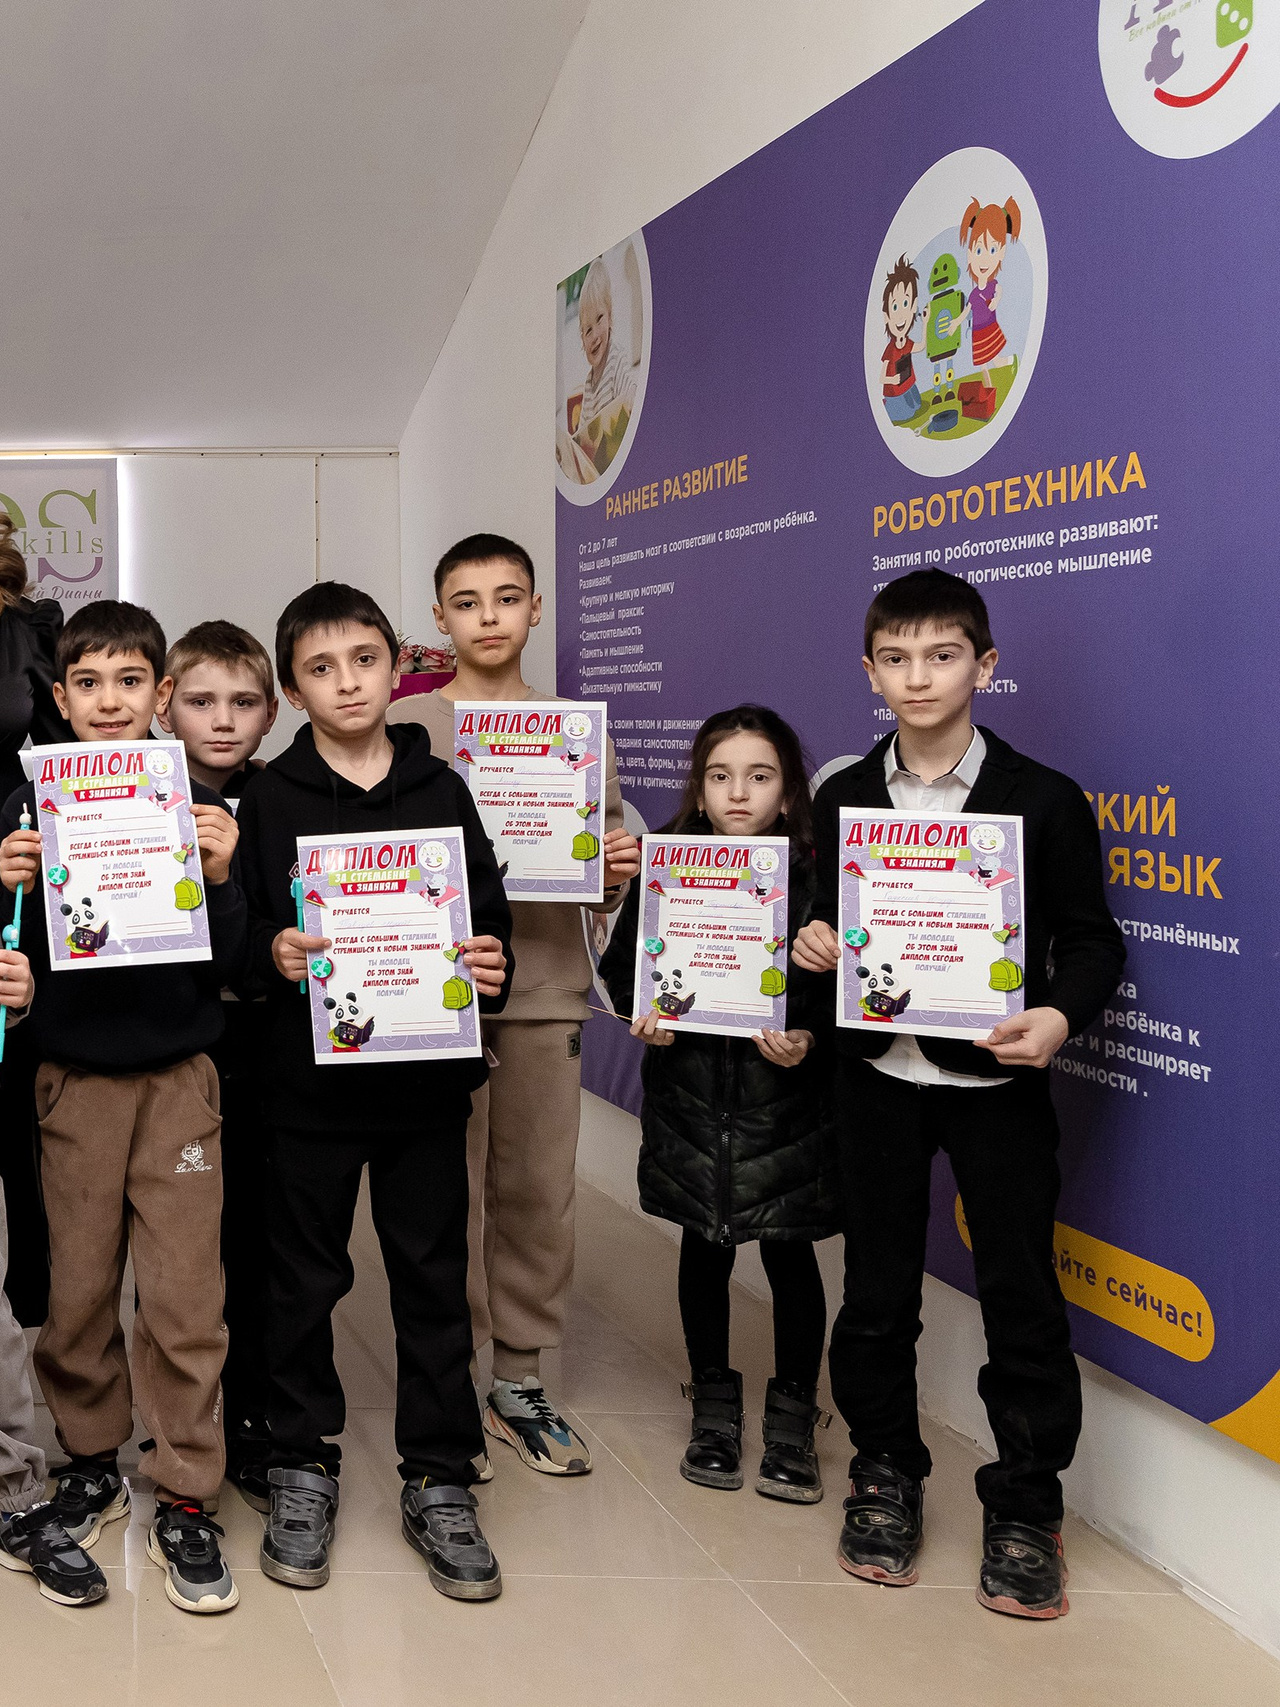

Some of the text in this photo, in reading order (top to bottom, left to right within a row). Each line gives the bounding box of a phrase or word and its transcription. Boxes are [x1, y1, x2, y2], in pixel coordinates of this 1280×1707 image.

[606, 454, 748, 520] РАННЕЕ РАЗВИТИЕ
[873, 451, 1147, 538] РОБОТОТЕХНИКА
[579, 510, 817, 572] Наша цель развивать мозг в соответсвии с возрастом ребёнка.
[579, 537, 618, 556] От 2 до 7 лет
[872, 514, 1158, 571] Занятия по робототехнике развивают:
[967, 546, 1152, 585] логическое мышление
[579, 575, 612, 590] Развиваем:
[51, 585, 103, 600] Дианы
[609, 592, 613, 602] и
[615, 588, 639, 601] мелкую
[641, 581, 674, 597] моторику
[618, 605, 644, 620] праксис
[604, 647, 608, 657] и
[609, 644, 644, 657] мышление
[620, 660, 662, 674] способности
[624, 680, 662, 693] гимнастику
[457, 711, 562, 736] ДИПЛОМ
[614, 720, 634, 729] своим
[636, 720, 655, 729] телом
[656, 720, 661, 729] и
[484, 734, 553, 744] ЗА СТРЕМЛЕНИЕ
[616, 738, 641, 749] задания
[503, 745, 541, 753] ЗНАНИЯМ
[38, 751, 145, 784] ДИПЛОМ
[626, 757, 646, 769] цвета,
[648, 756, 675, 771] формы,
[66, 775, 139, 790] ЗА СТРЕМЛЕНИЕ
[637, 776, 641, 785] и
[79, 787, 128, 799] К ЗНАНИЯМ
[66, 812, 102, 822] ВРУЧАЕТСЯ
[844, 821, 968, 848] ДИПЛОМ
[650, 845, 750, 870] ДИПЛОМ
[876, 846, 960, 857] ЗА СТРЕМЛЕНИЕ
[304, 843, 417, 876] ДИПЛОМ
[889, 858, 945, 868] К ЗНАНИЯМ
[334, 869, 410, 883] ЗА СТРЕМЛЕНИЕ
[674, 867, 742, 877] ЗА СТРЕМЛЕНИЕ
[1108, 847, 1223, 899] ЯЗЫК
[347, 881, 398, 892] К ЗНАНИЯМ
[693, 878, 730, 887] ЗНАНИЯМ
[871, 881, 913, 889] ВРУЧАЕТСЯ
[332, 907, 370, 916] ВРУЧАЕТСЯ
[872, 908, 898, 916] ВСЕГДА
[907, 909, 943, 918] БОЛЬШИМ
[946, 911, 985, 919] СТАРАНИЕМ
[869, 918, 916, 927] СТРЕМИШЬСЯ
[925, 920, 953, 928] НОВЫМ
[955, 922, 994, 931] ЗНАНИЯМ!
[905, 942, 958, 952] ОБ ЭТОМ ЗНАЙ
[899, 953, 964, 962] ДИПЛОМ СЕГОДНЯ
[914, 963, 950, 971] ПОЛУЧАЙ!
[1104, 1008, 1183, 1043] ребёнка
[1188, 1029, 1200, 1047] к
[1089, 1034, 1100, 1052] и
[1105, 1039, 1211, 1083] расширяет
[1106, 1276, 1202, 1337] сейчас!
